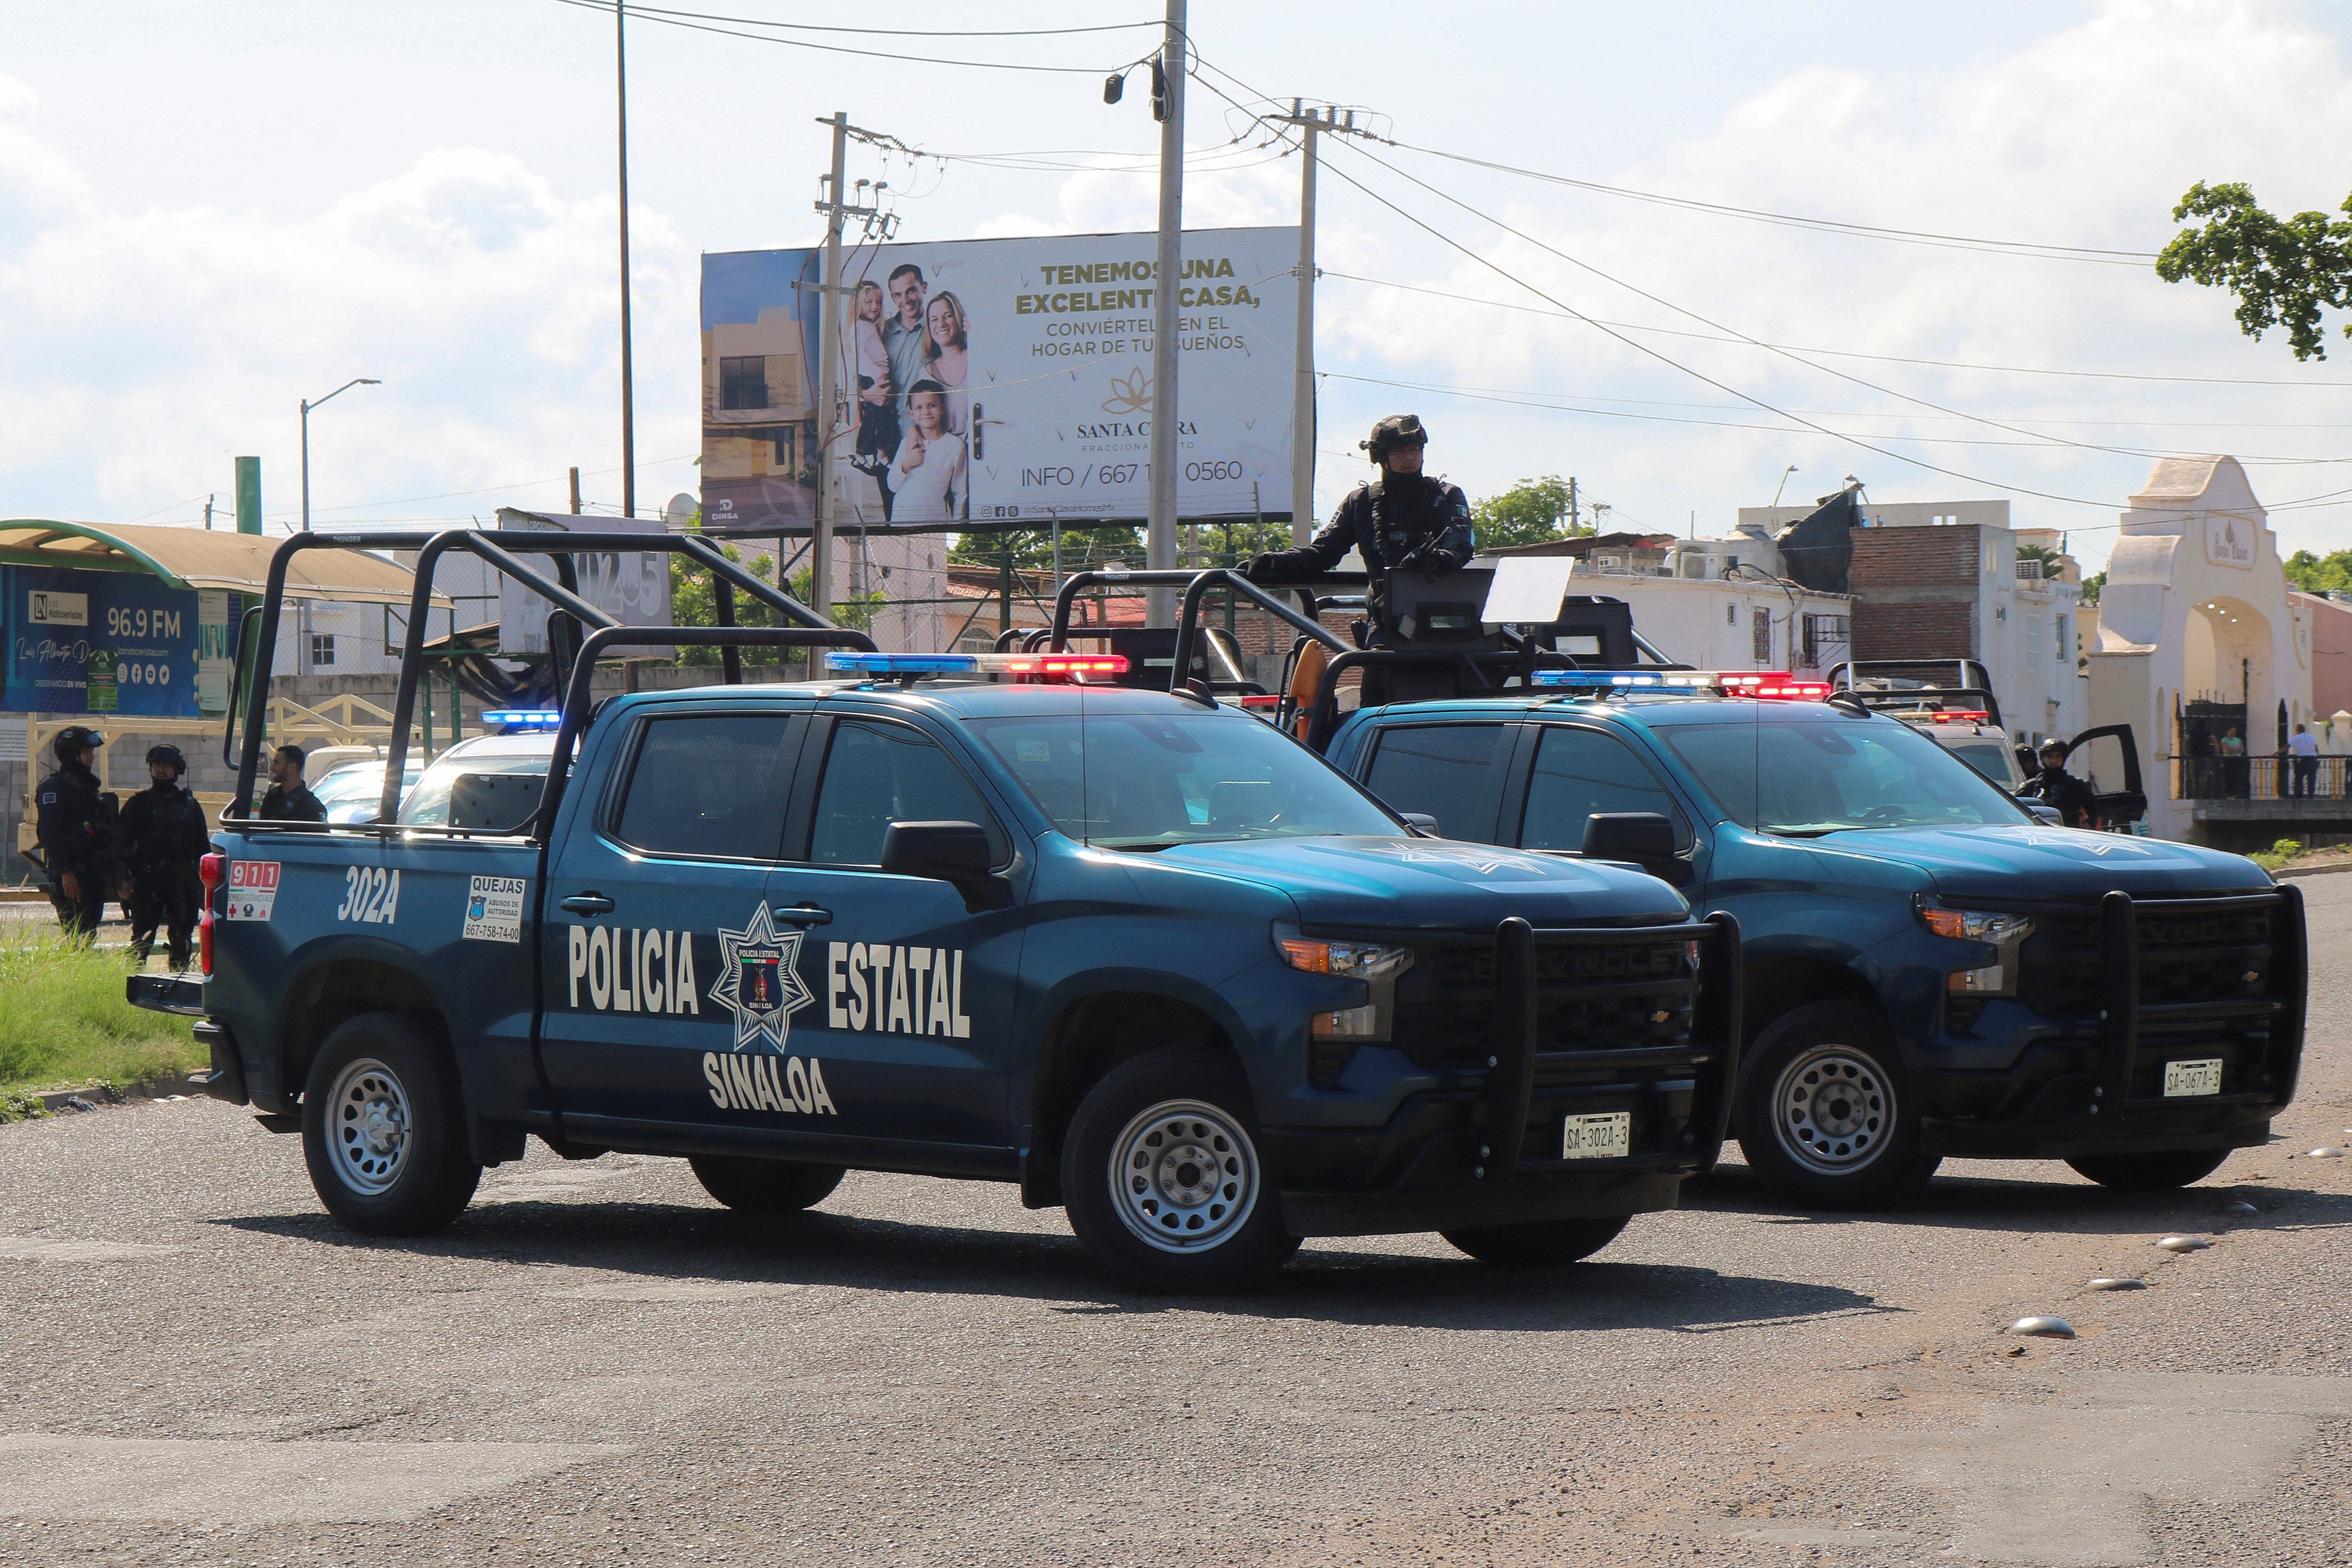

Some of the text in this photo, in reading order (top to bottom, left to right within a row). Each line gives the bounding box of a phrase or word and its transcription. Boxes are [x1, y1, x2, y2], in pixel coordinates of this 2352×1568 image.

[1180, 258, 1234, 280] UNA
[1017, 285, 1259, 314] EXCELENT CASA,
[1046, 317, 1155, 336] CONVIÉRTEL
[1209, 317, 1229, 330] EL
[1032, 342, 1096, 357] HOGAR
[1103, 340, 1125, 354] DE
[1132, 338, 1153, 352] TU
[1077, 421, 1197, 439] SANTA CRA
[1022, 467, 1074, 486] INFO
[1099, 464, 1138, 484] 667
[1186, 461, 1242, 481] 0560
[108, 607, 181, 638] 96.9 FM
[233, 865, 275, 884] 911
[337, 865, 400, 925] 302A
[473, 877, 523, 894] QUEJAS
[228, 893, 274, 902] EMERGENCIAS
[487, 907, 518, 917] AUTORIDAD
[466, 924, 519, 940] 667-758-74-00
[739, 949, 759, 958] POLICIA
[569, 925, 971, 1039] POLICIA ESTATAL
[703, 1052, 838, 1116] SINALOA
[2168, 1070, 2219, 1091] SA-067A-3
[1567, 1126, 1627, 1150] SA-302A-3
